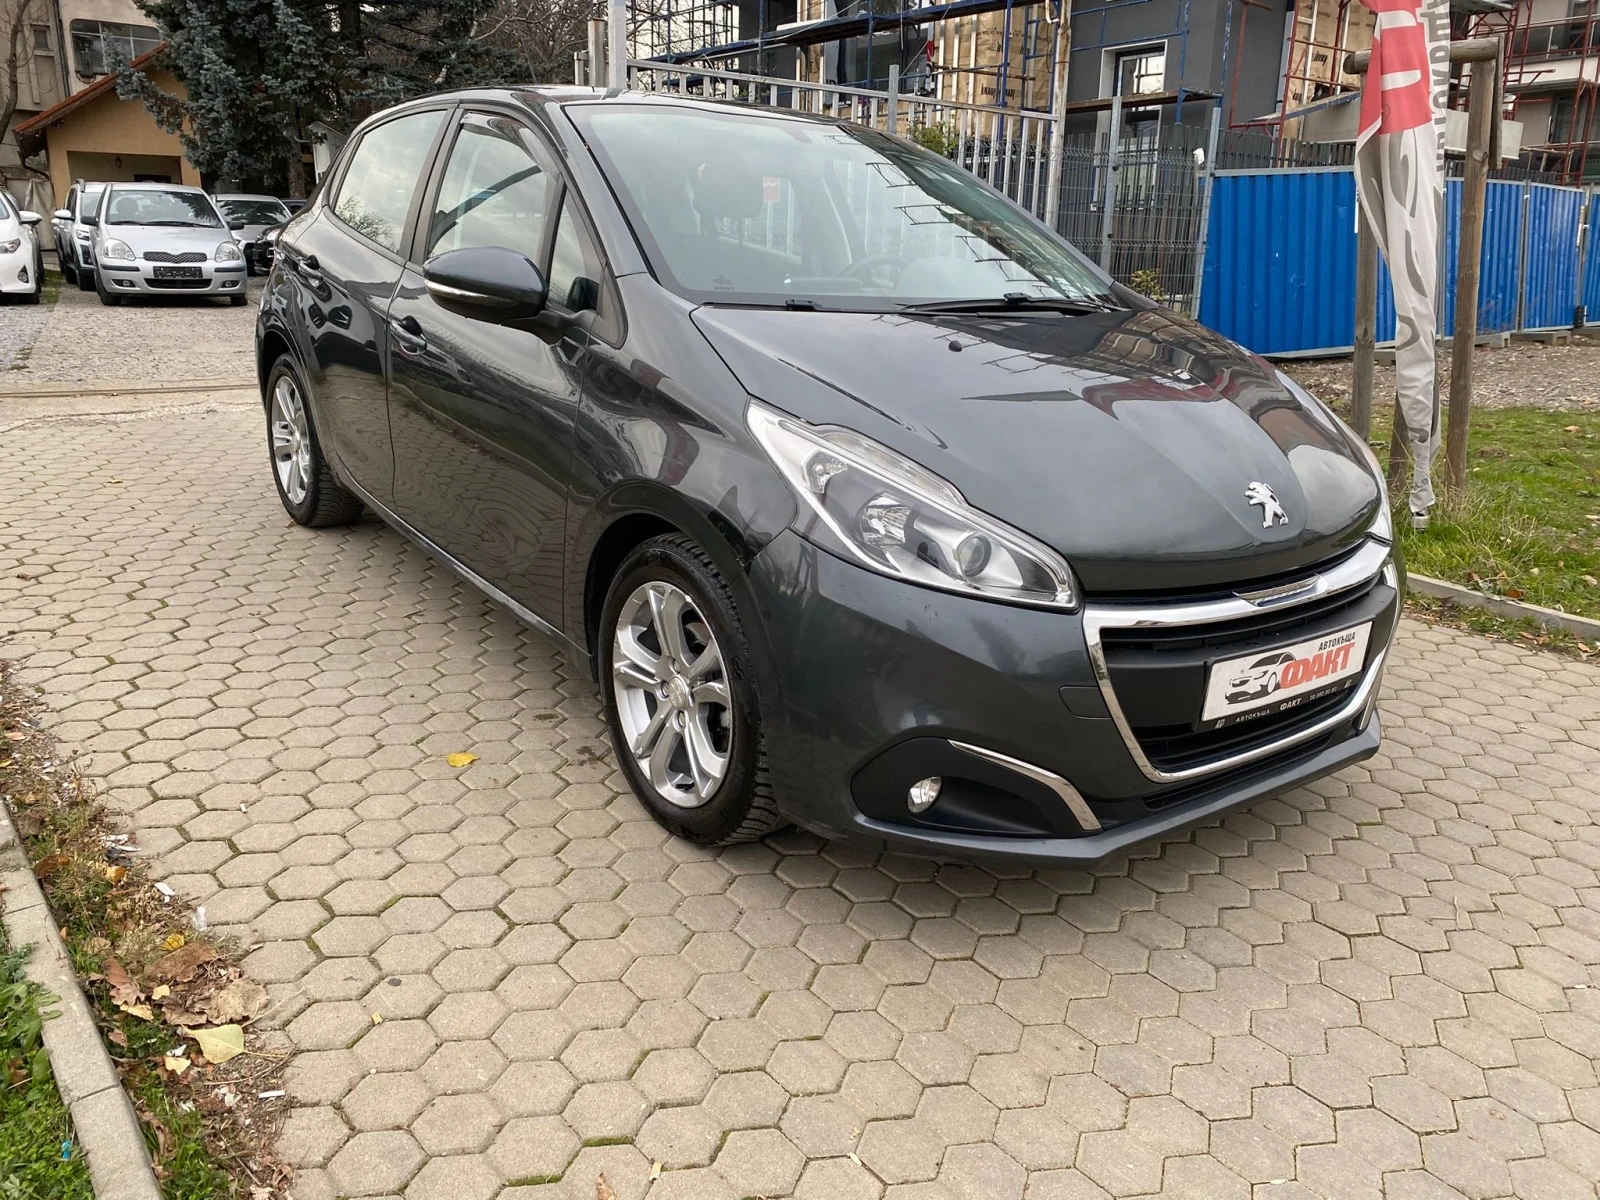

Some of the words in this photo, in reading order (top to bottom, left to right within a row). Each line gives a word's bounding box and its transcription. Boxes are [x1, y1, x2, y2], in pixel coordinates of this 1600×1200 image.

[1318, 631, 1356, 652] АВТОКЪЩА
[1280, 642, 1355, 689] ФАКТ
[1280, 698, 1302, 711] ФАКТ
